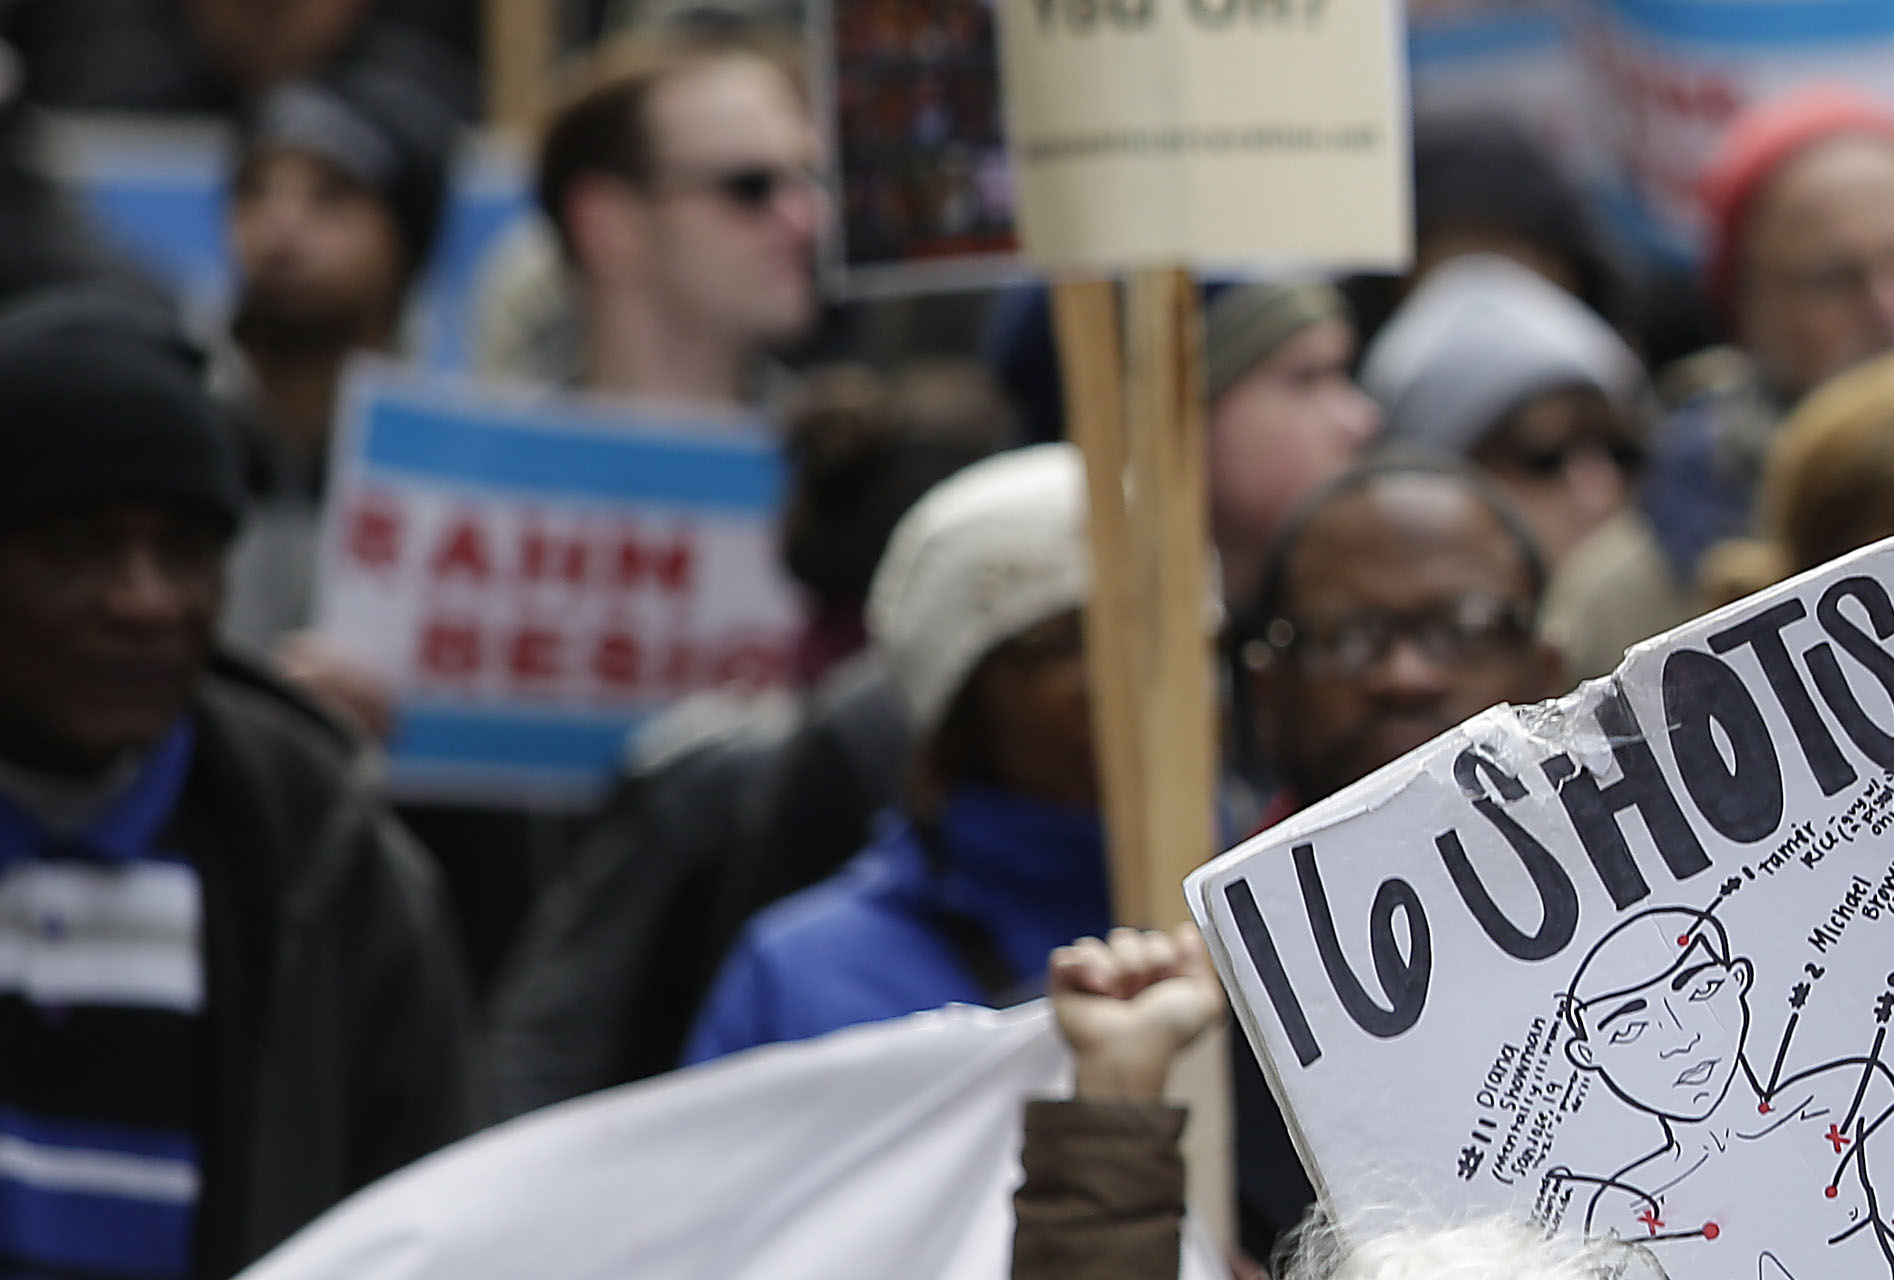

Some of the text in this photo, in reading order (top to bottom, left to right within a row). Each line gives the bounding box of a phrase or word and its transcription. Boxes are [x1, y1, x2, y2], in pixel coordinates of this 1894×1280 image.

[1807, 875, 1872, 954] Michael
[1223, 842, 1433, 1068] 16
[1475, 1042, 1522, 1110] Diana
